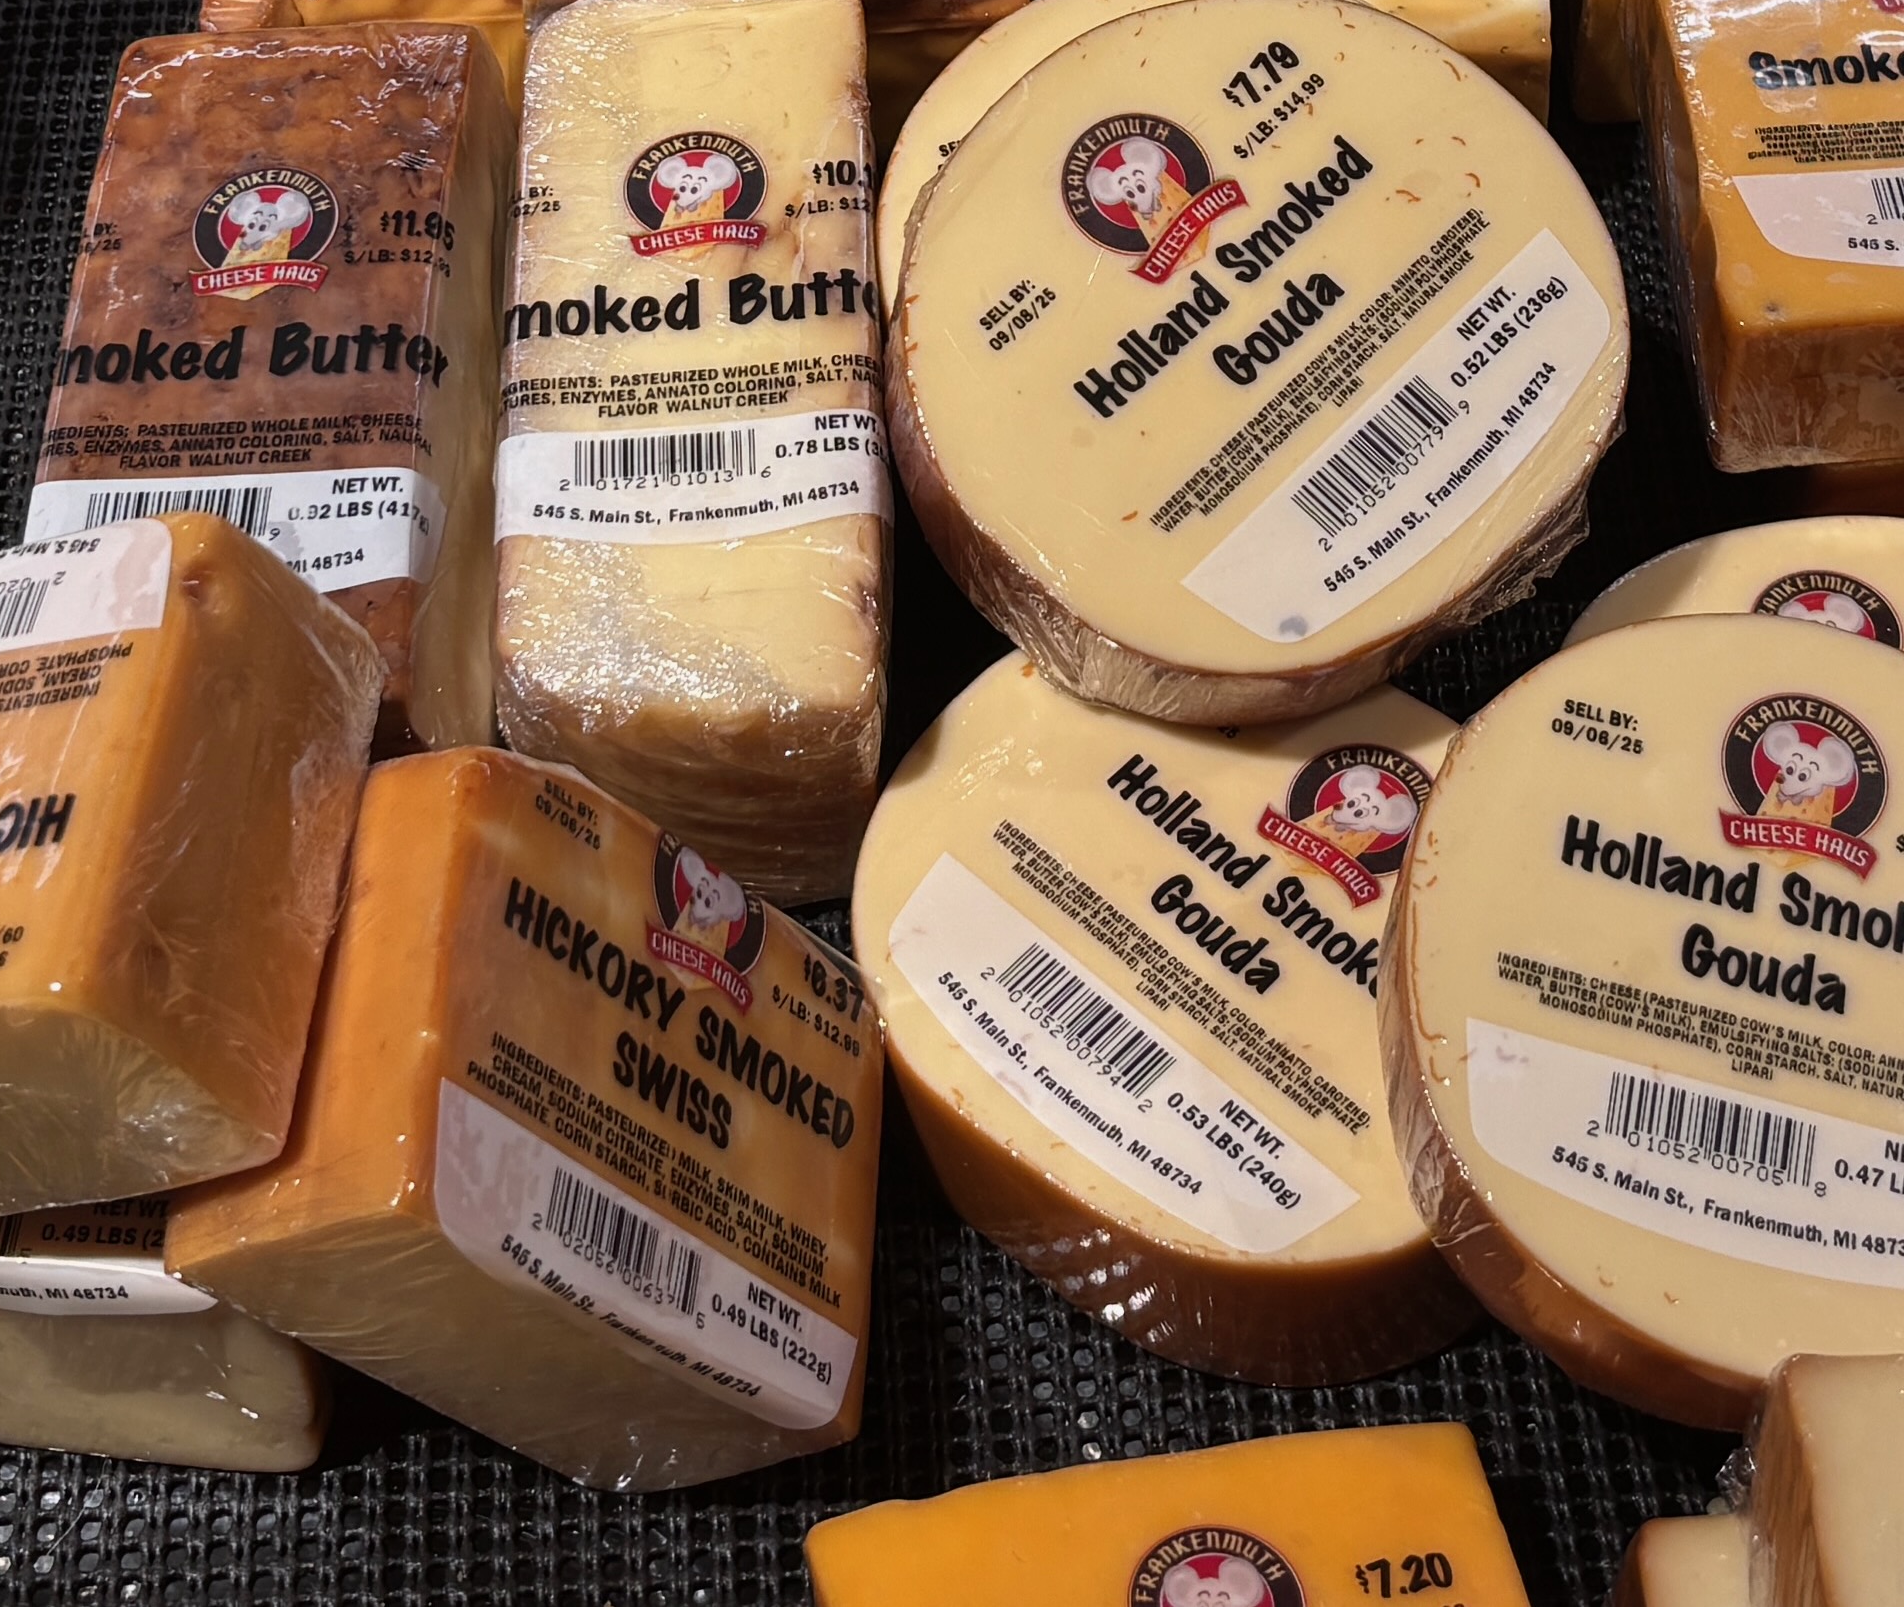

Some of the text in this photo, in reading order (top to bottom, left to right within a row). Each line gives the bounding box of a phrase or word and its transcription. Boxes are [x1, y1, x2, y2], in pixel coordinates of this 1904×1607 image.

[1223, 39, 1300, 108] $7.79
[1072, 134, 1374, 419] Holland Smoked
[1211, 266, 1345, 385] Gouda
[1107, 752, 1269, 889] Holland
[1559, 815, 1761, 916] Holland
[1150, 872, 1280, 994] Gouda
[1680, 922, 1848, 1016] Gouda
[503, 877, 856, 1150] HICKORY SMOKED
[613, 1030, 733, 1151] SWISS
[1355, 1552, 1454, 1598] $7.20
